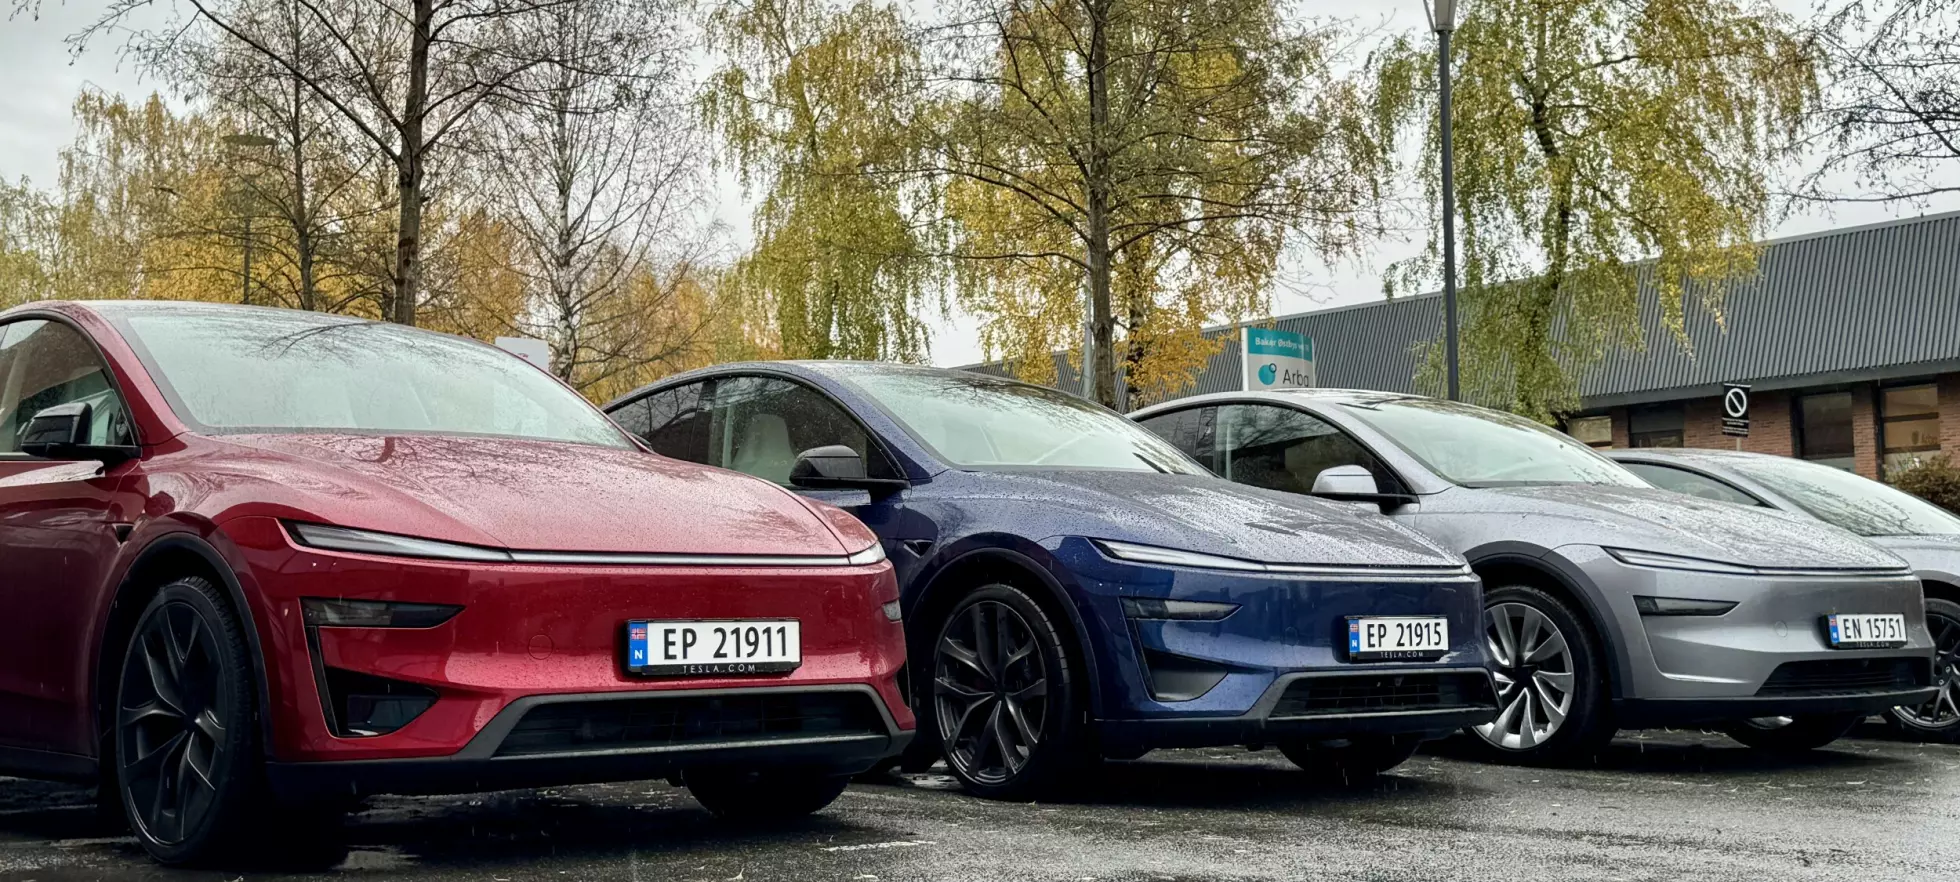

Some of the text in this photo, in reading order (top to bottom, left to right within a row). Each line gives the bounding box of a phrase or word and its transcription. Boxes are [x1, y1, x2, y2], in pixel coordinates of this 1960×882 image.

[1283, 369, 1309, 387] Arba
[1367, 622, 1441, 647] EP 21915
[1843, 617, 1902, 639] EN 15751
[664, 626, 787, 660] EP 21911
[634, 649, 643, 660] N
[1380, 651, 1424, 659] TESLA.COM
[683, 664, 756, 674] TESLA.COM
